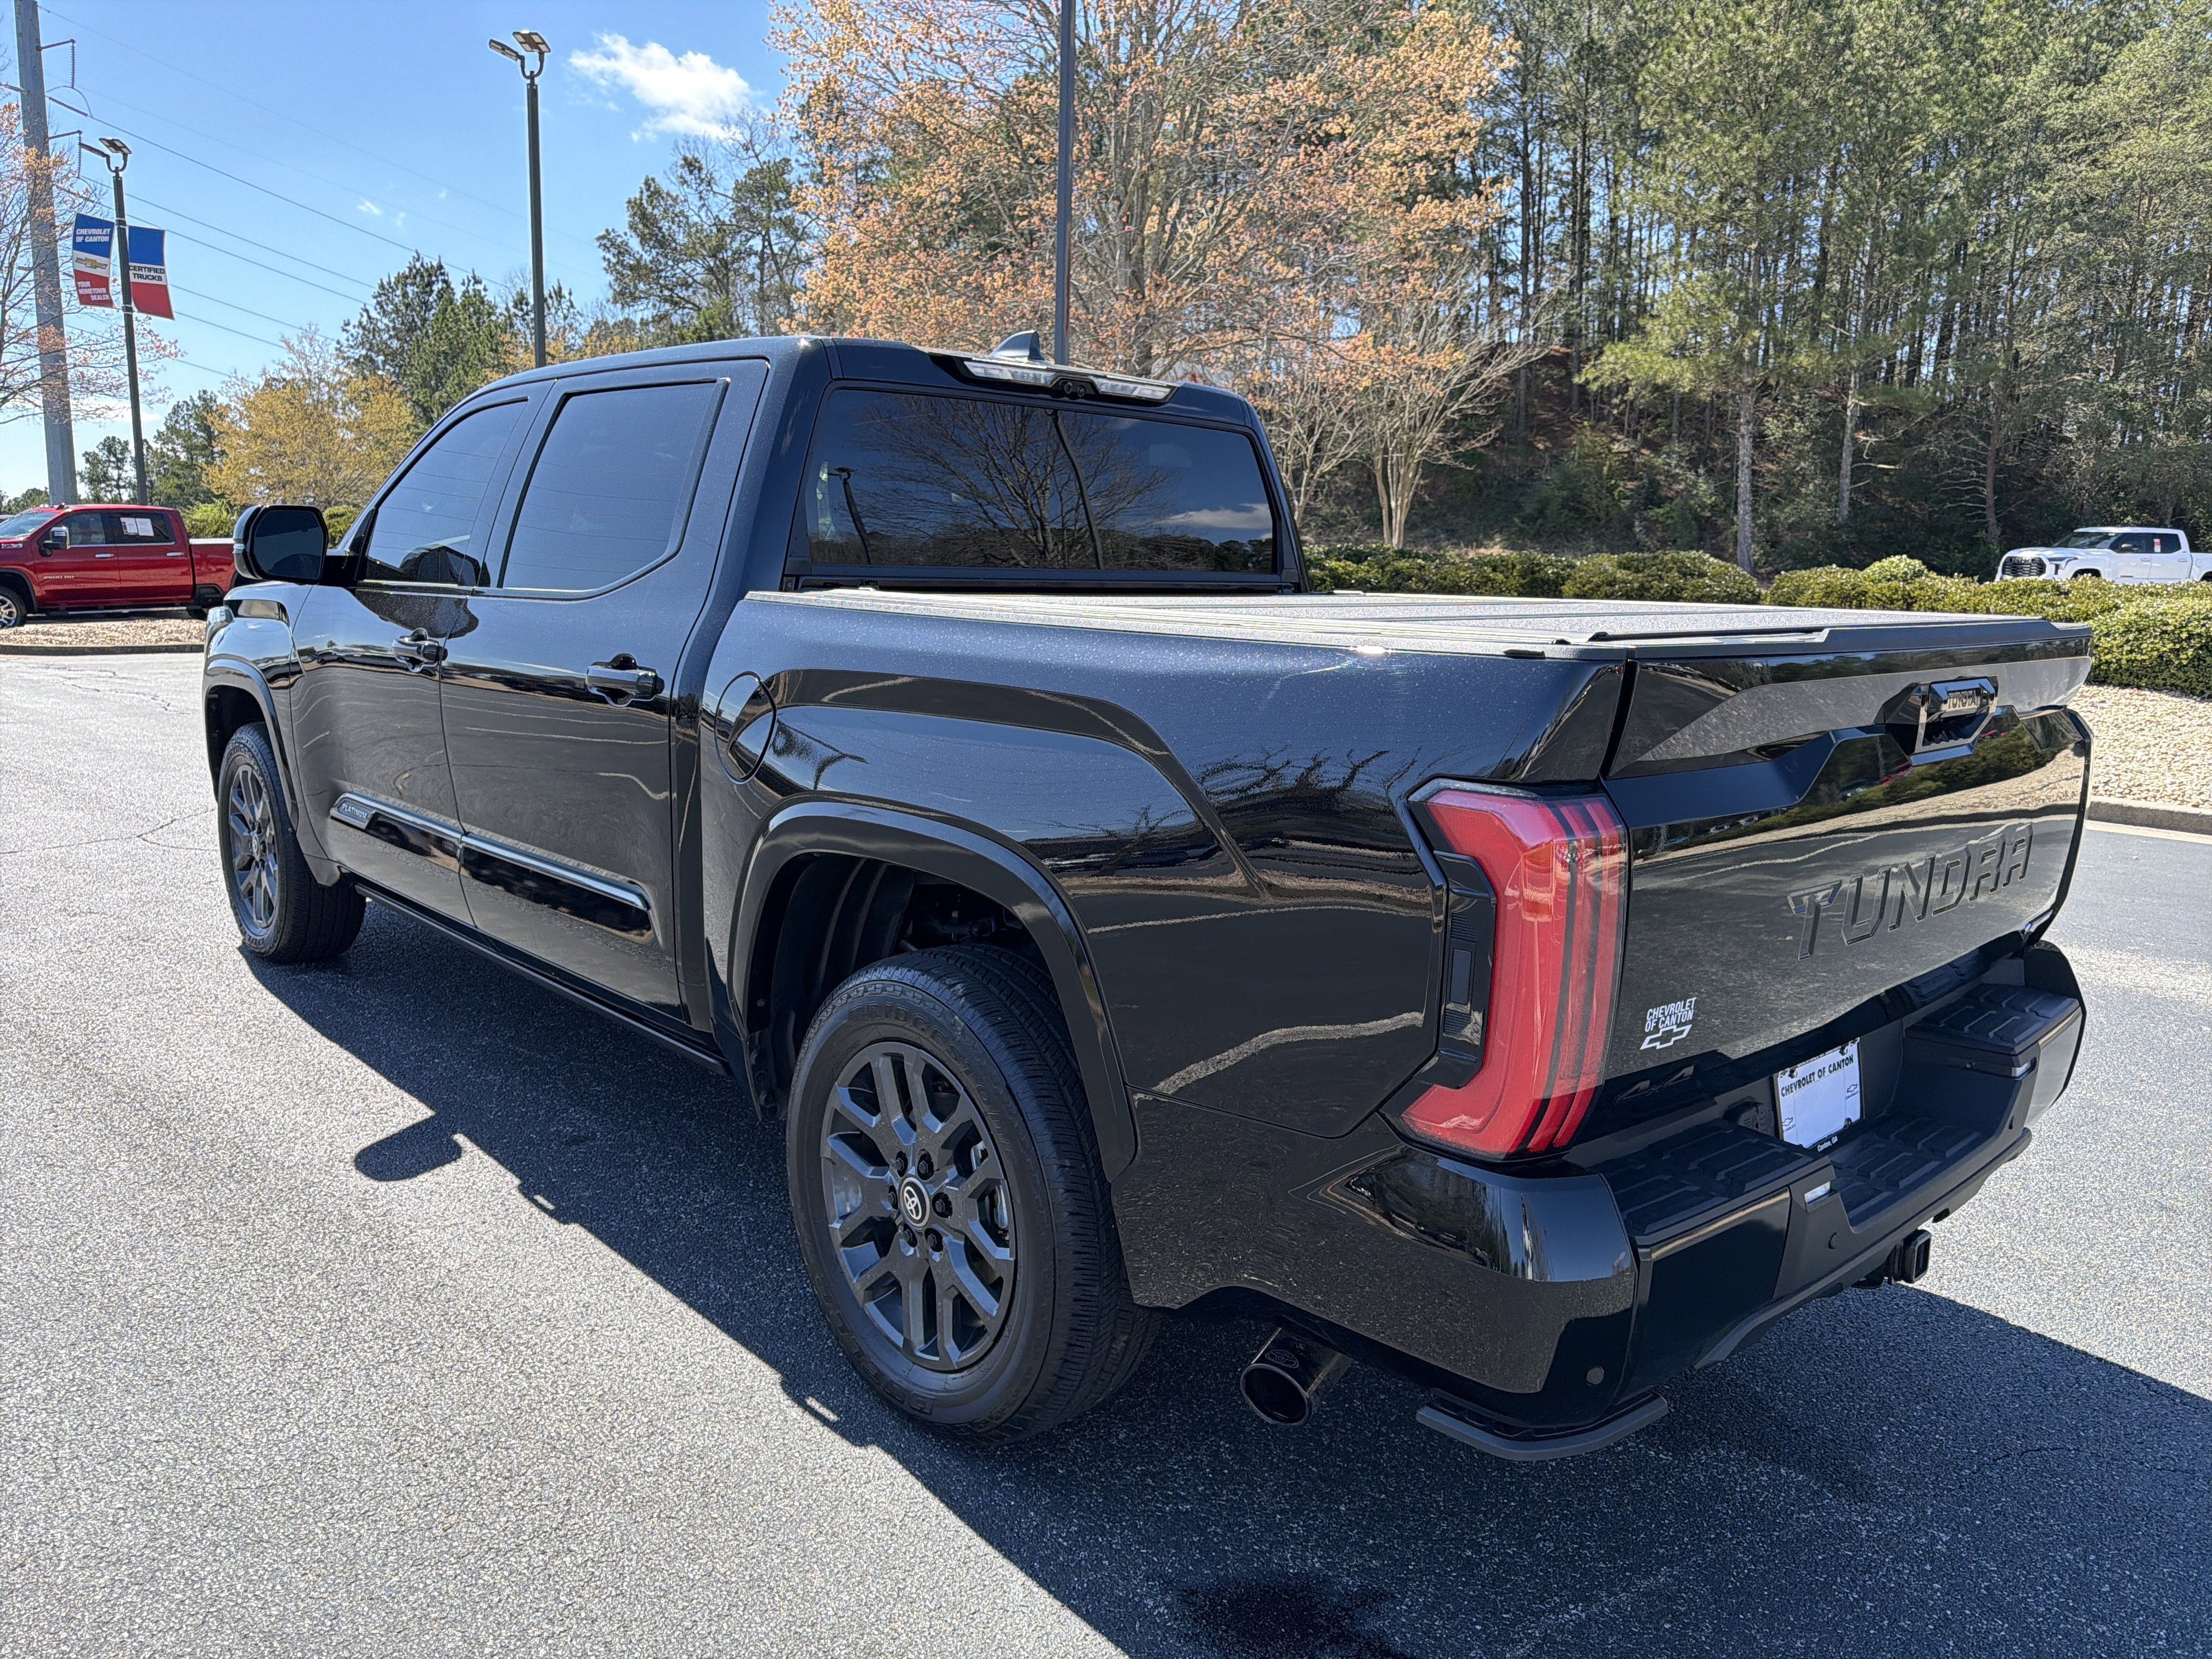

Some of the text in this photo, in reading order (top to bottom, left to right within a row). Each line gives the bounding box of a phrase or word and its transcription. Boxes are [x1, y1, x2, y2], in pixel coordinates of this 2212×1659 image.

[128, 266, 165, 274] CERTIFIED
[132, 273, 163, 281] TRUCKS
[1948, 690, 1976, 709] TOYOTA
[342, 803, 368, 820] PLATINUM
[1787, 822, 2034, 961] TUNDRA
[1646, 997, 1697, 1021] CHEVROLET
[1645, 1008, 1694, 1032] OF CANTON
[1781, 1071, 1816, 1098] CHEVROLET
[1817, 1066, 1826, 1078] OF
[1828, 1054, 1854, 1074] CANTON
